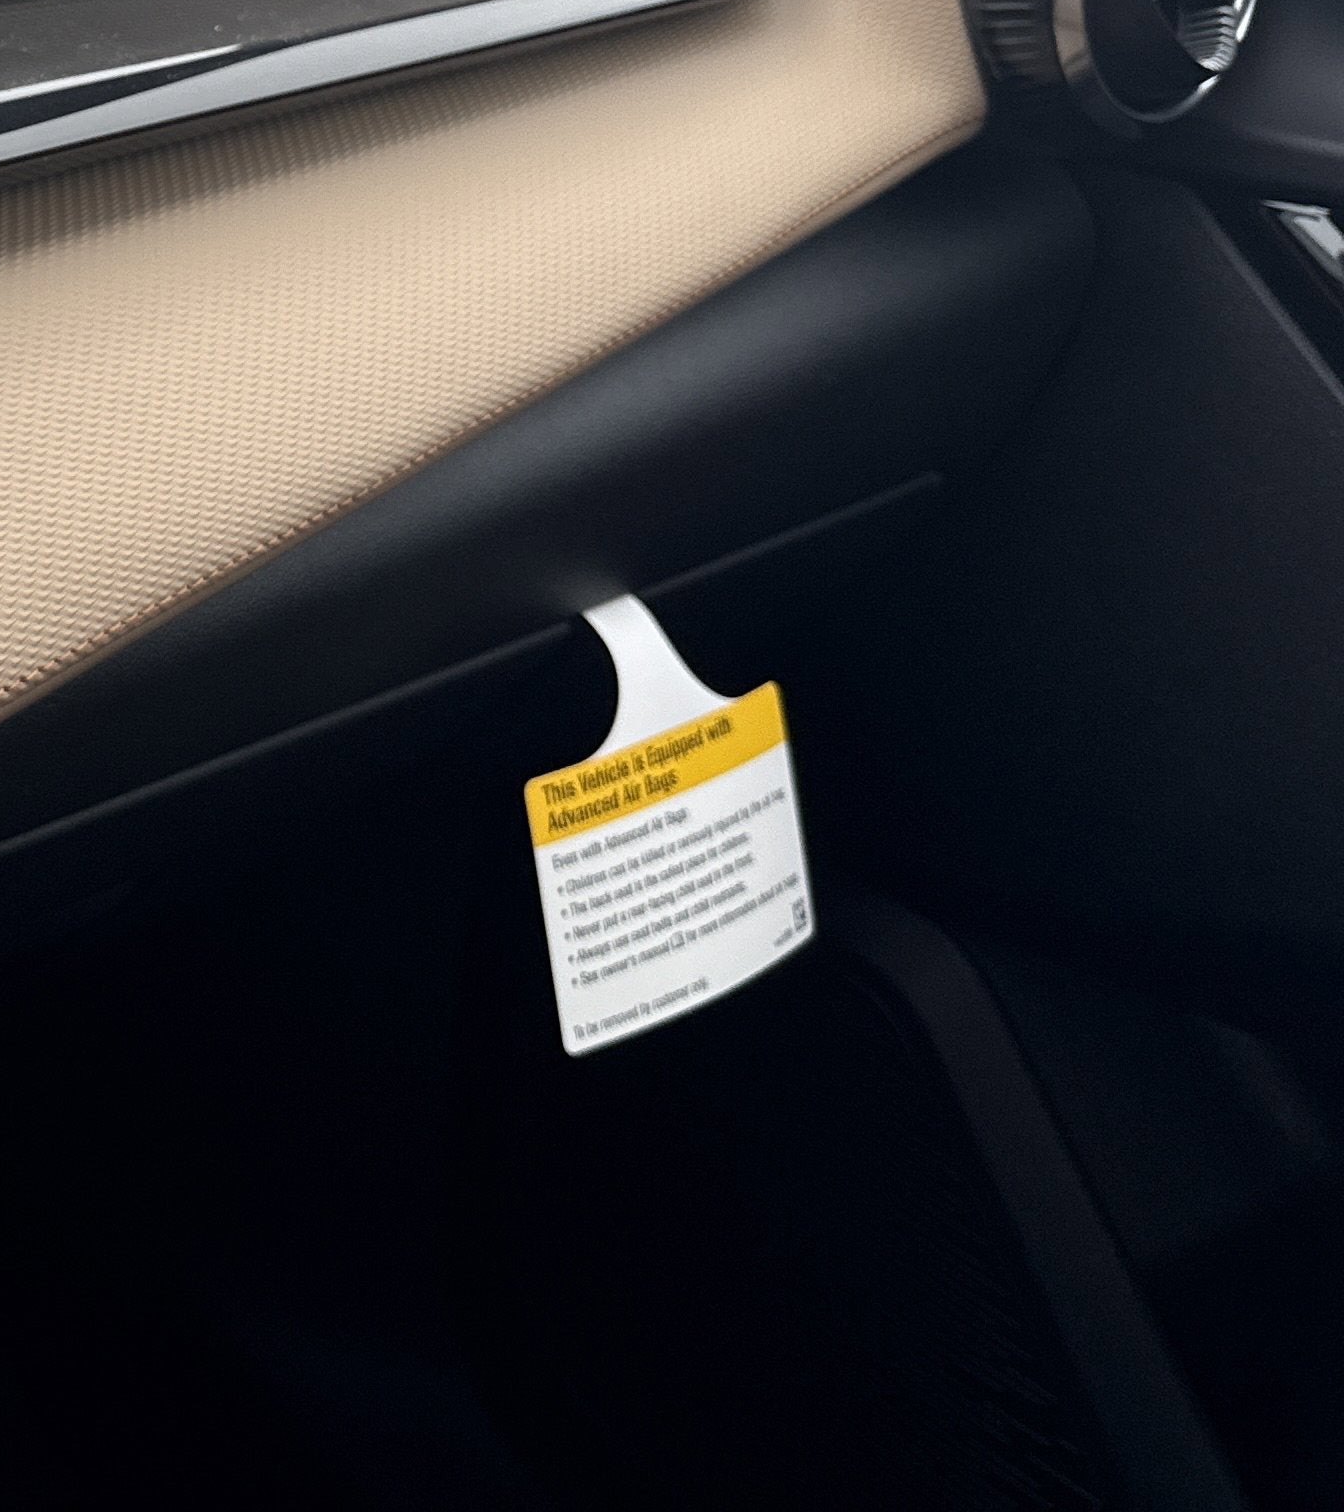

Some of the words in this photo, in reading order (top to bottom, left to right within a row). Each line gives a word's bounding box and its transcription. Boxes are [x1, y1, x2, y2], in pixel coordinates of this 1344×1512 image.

[541, 779, 577, 806] This
[577, 758, 630, 794] Vehicle
[630, 752, 646, 773] is
[645, 727, 704, 769] Equipped
[704, 715, 733, 742] with
[548, 787, 619, 835] Advanced
[622, 782, 643, 806] Air
[643, 767, 679, 797] Bags
[552, 851, 579, 872] Even
[579, 841, 602, 861] with
[604, 821, 650, 850] Advanced
